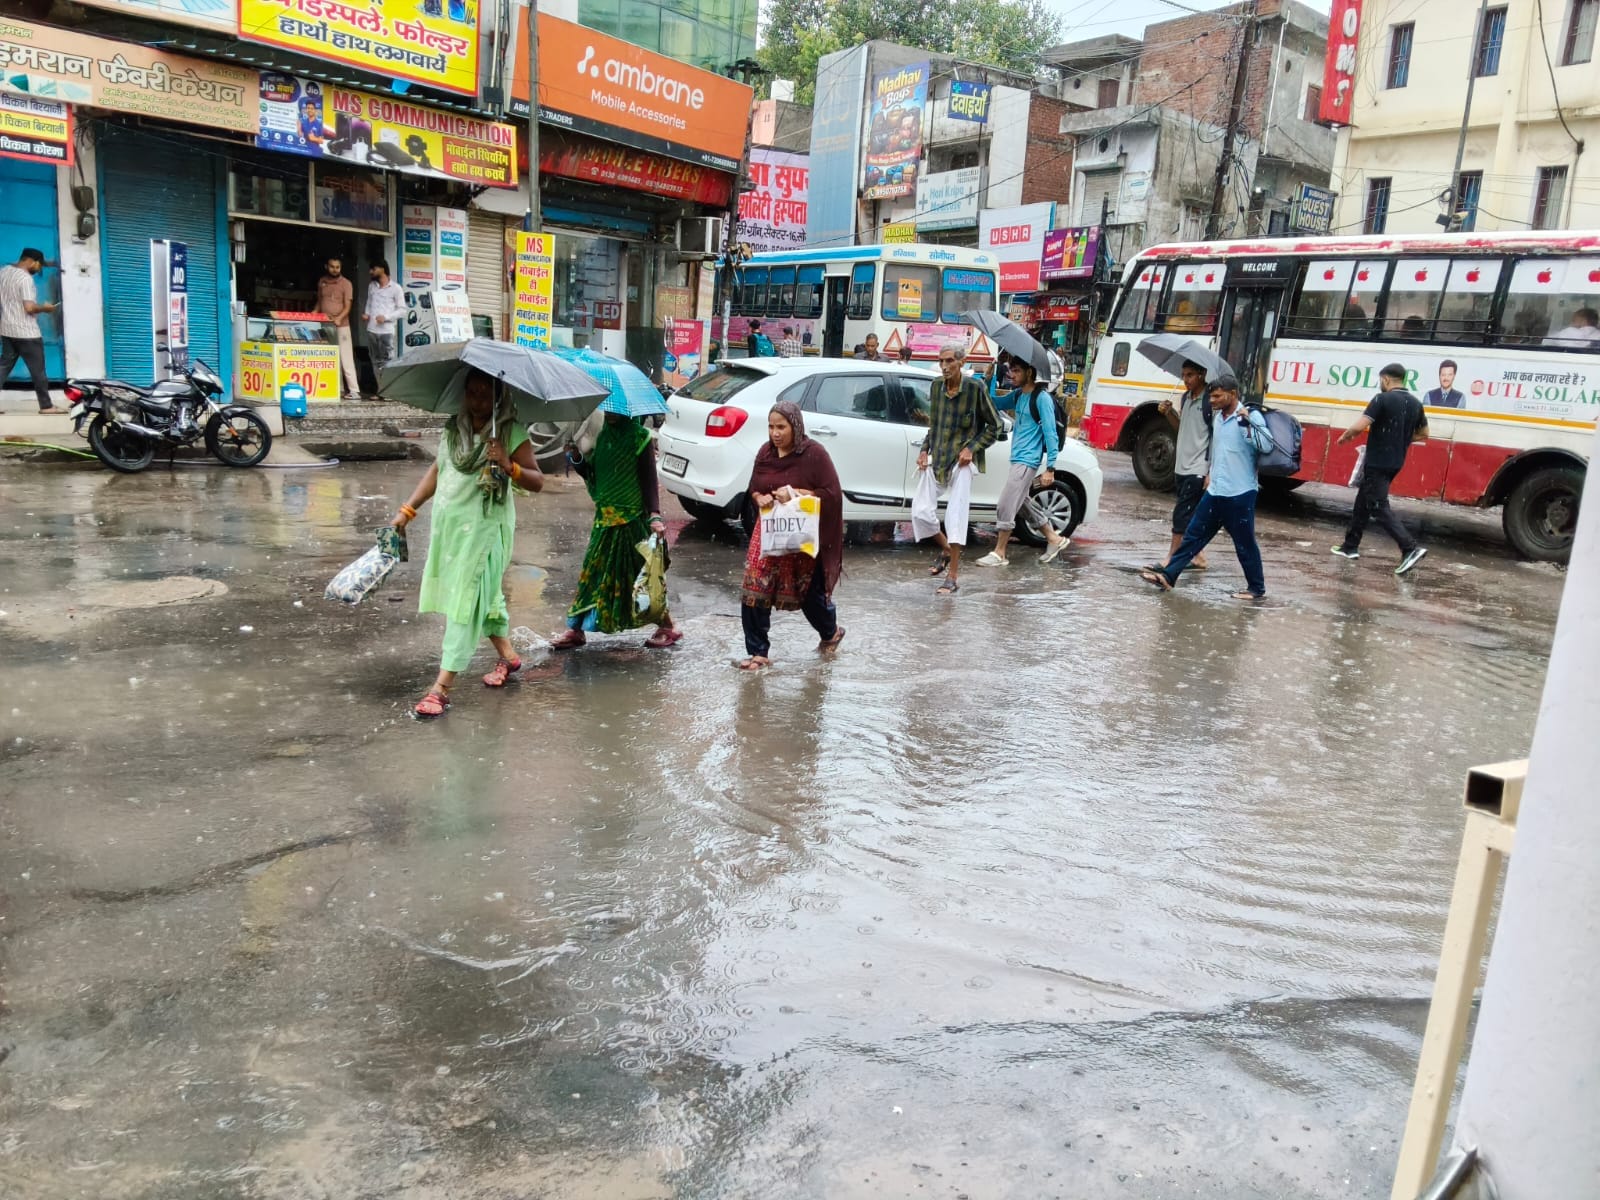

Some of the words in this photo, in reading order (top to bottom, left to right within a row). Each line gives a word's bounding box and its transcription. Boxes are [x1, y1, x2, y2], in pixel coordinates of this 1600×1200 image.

[331, 29, 371, 54] हाथ
[394, 20, 470, 56] फोल्डर
[97, 52, 246, 107] फैबरीकेशन
[260, 81, 276, 92] Jio
[604, 58, 705, 109] ambrane
[877, 69, 921, 97] Madhav
[306, 86, 319, 96] Jio
[886, 86, 911, 108] Bags
[30, 98, 62, 115] बिरयानी
[591, 88, 627, 112] Mobile
[628, 102, 687, 130] Accessories
[5, 113, 31, 129] चिकन
[33, 118, 65, 135] बिरयानी
[333, 88, 362, 116] MS
[368, 97, 513, 147] COMMUNICATION
[545, 109, 573, 126] TRADERS
[1302, 197, 1330, 217] GUEST
[1298, 211, 1329, 231] HOUSE
[884, 226, 914, 238] MADHAV
[991, 225, 1030, 243] USHA
[526, 237, 543, 253] MS
[1242, 262, 1277, 272] WELCOME
[595, 302, 620, 320] LED
[243, 370, 272, 395] 30/-
[1272, 359, 1321, 386] UTL
[1326, 363, 1420, 393] SOLR
[1503, 370, 1519, 381] आप
[1519, 372, 1534, 382] कब
[1534, 372, 1557, 384] लगवा
[1559, 372, 1572, 385] रहे
[1487, 381, 1527, 399] UTL
[763, 517, 807, 533] TRIDEV
